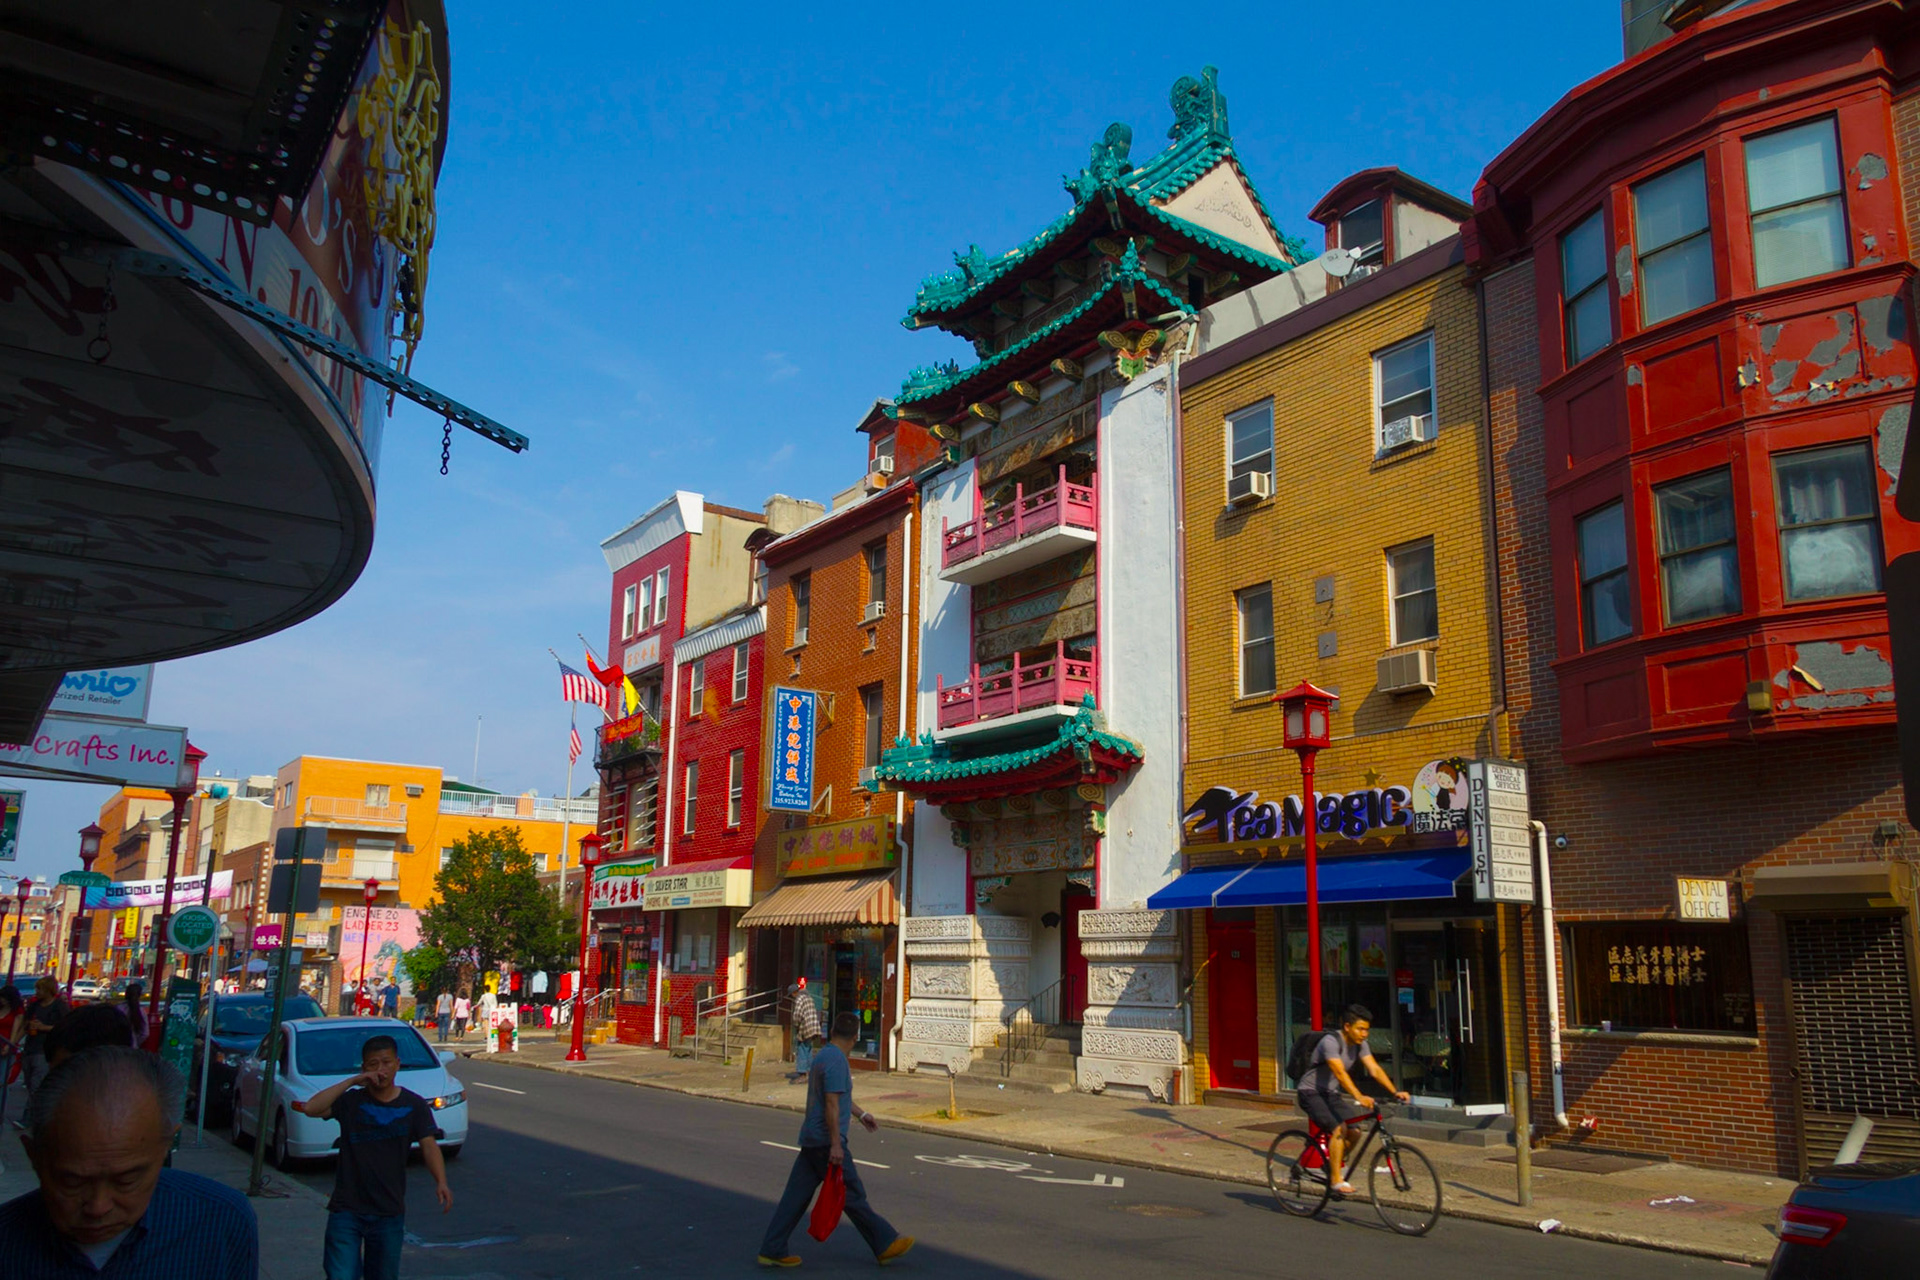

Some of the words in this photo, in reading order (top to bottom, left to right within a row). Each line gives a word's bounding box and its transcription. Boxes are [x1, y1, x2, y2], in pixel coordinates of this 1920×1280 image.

[55, 692, 85, 701] orized
[88, 694, 121, 705] Retailer
[33, 735, 119, 766] Crafts
[129, 744, 175, 766] Inc.
[1491, 765, 1513, 776] DENTAL
[1494, 773, 1521, 784] MEDICAL
[1495, 780, 1521, 791] OFFICES
[1182, 786, 1281, 843] Tea
[1413, 808, 1466, 834] 魔法茶
[1472, 778, 1487, 884] DENTIST
[60, 874, 95, 886] Cherry
[655, 880, 672, 891] SILVER
[673, 878, 687, 890] STAR
[106, 885, 151, 897] NIGHT
[156, 879, 206, 893] MRKET
[1681, 880, 1724, 897] DENTAL
[346, 908, 382, 919] ENGNE
[385, 910, 398, 919] 20
[1684, 901, 1722, 917] OFFICE
[345, 920, 383, 931] LADER
[385, 922, 399, 931] 23
[344, 933, 374, 943] MEDC
